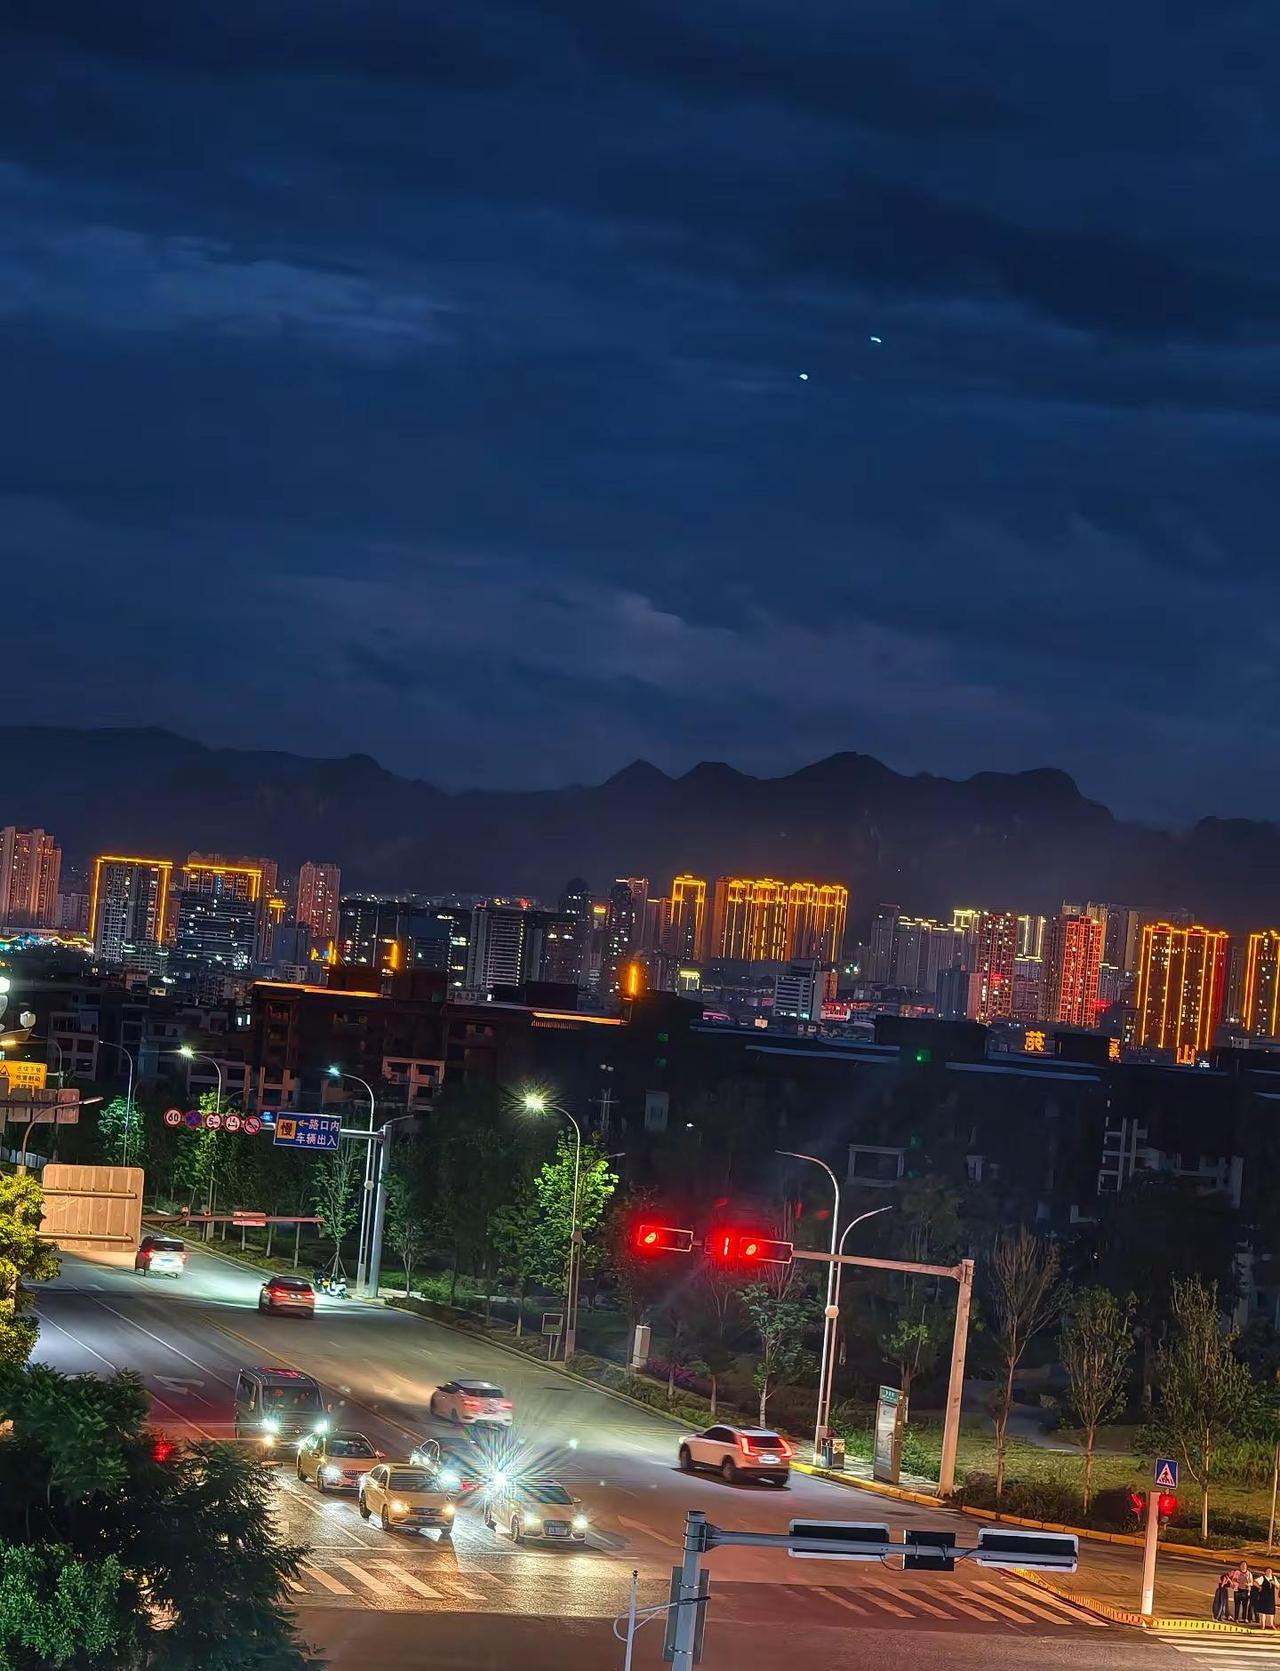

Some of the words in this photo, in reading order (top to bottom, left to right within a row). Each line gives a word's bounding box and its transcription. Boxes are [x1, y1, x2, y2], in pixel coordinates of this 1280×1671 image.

[168, 1113, 179, 1122] 60
[281, 1121, 293, 1137] 慢
[308, 1119, 340, 1132] 路口内
[296, 1132, 337, 1147] 车辆出入
